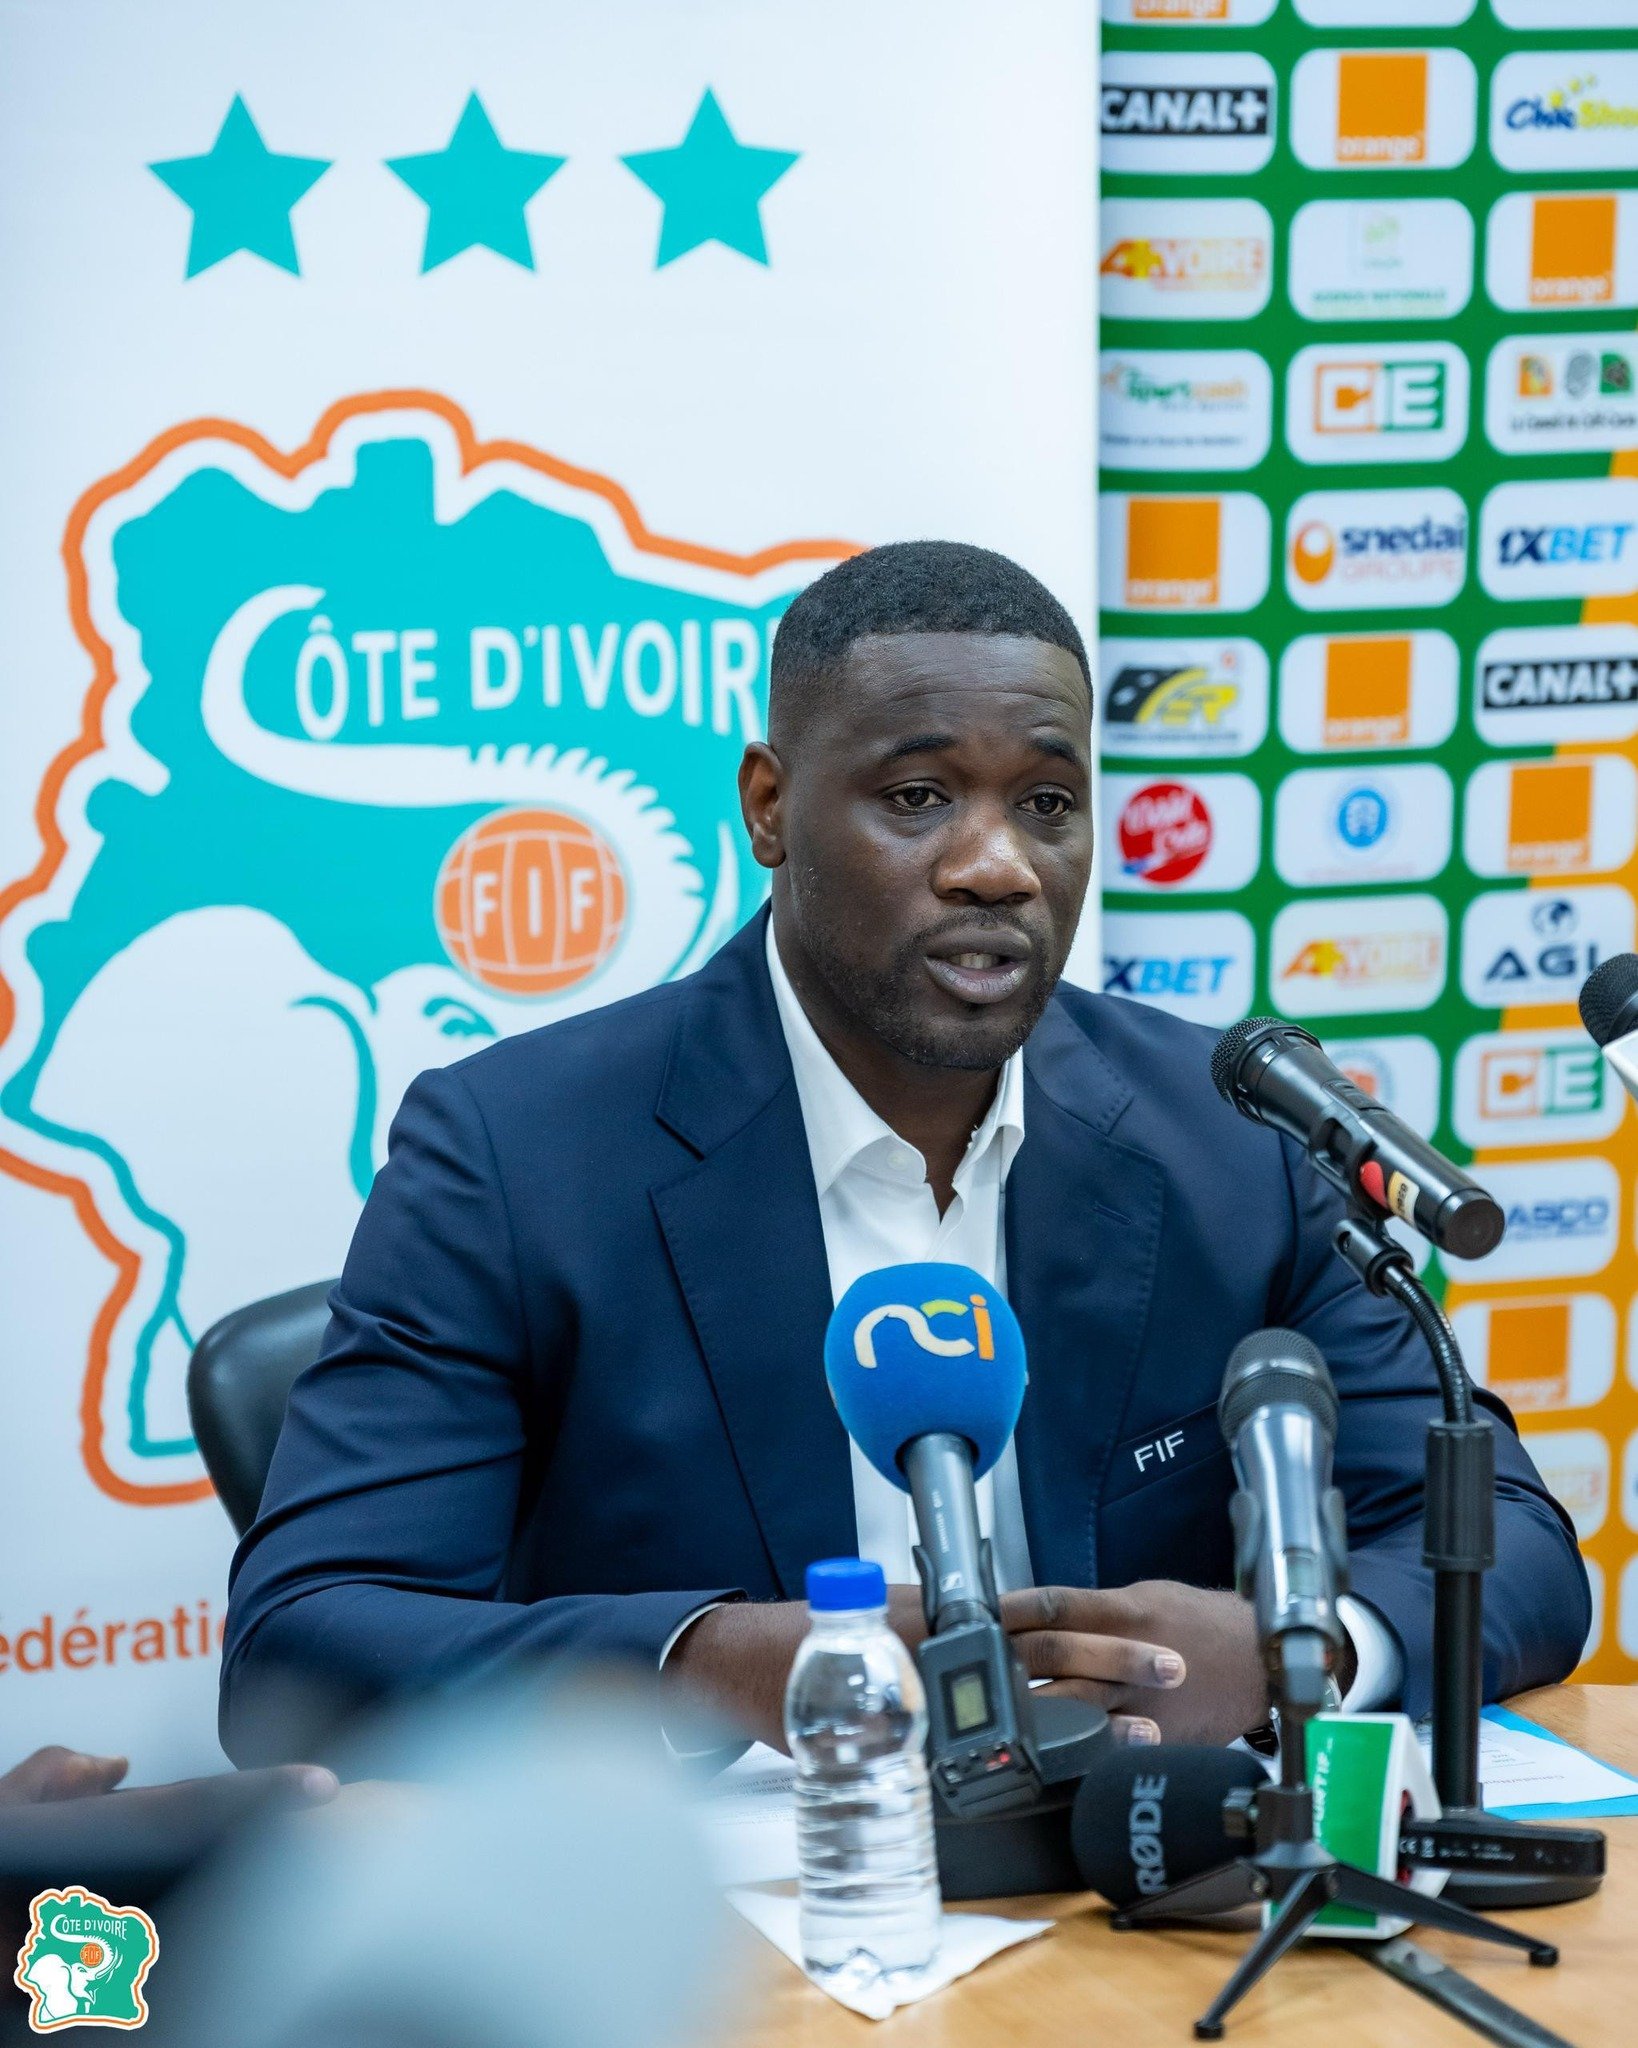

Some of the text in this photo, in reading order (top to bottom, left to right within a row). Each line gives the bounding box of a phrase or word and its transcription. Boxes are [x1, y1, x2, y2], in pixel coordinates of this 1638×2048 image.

[1100, 89, 1267, 130] CANAL+
[1338, 137, 1420, 159] orange
[1531, 279, 1610, 302] orange
[1341, 516, 1464, 553] snedai
[470, 617, 776, 745] D'IVOIR
[1488, 664, 1638, 704] CANAL+
[472, 867, 595, 938] FIF
[1102, 954, 1233, 994] XBET
[854, 1293, 995, 1370] nci
[1134, 1431, 1185, 1472] FIF
[1129, 1773, 1168, 1895] RØDE
